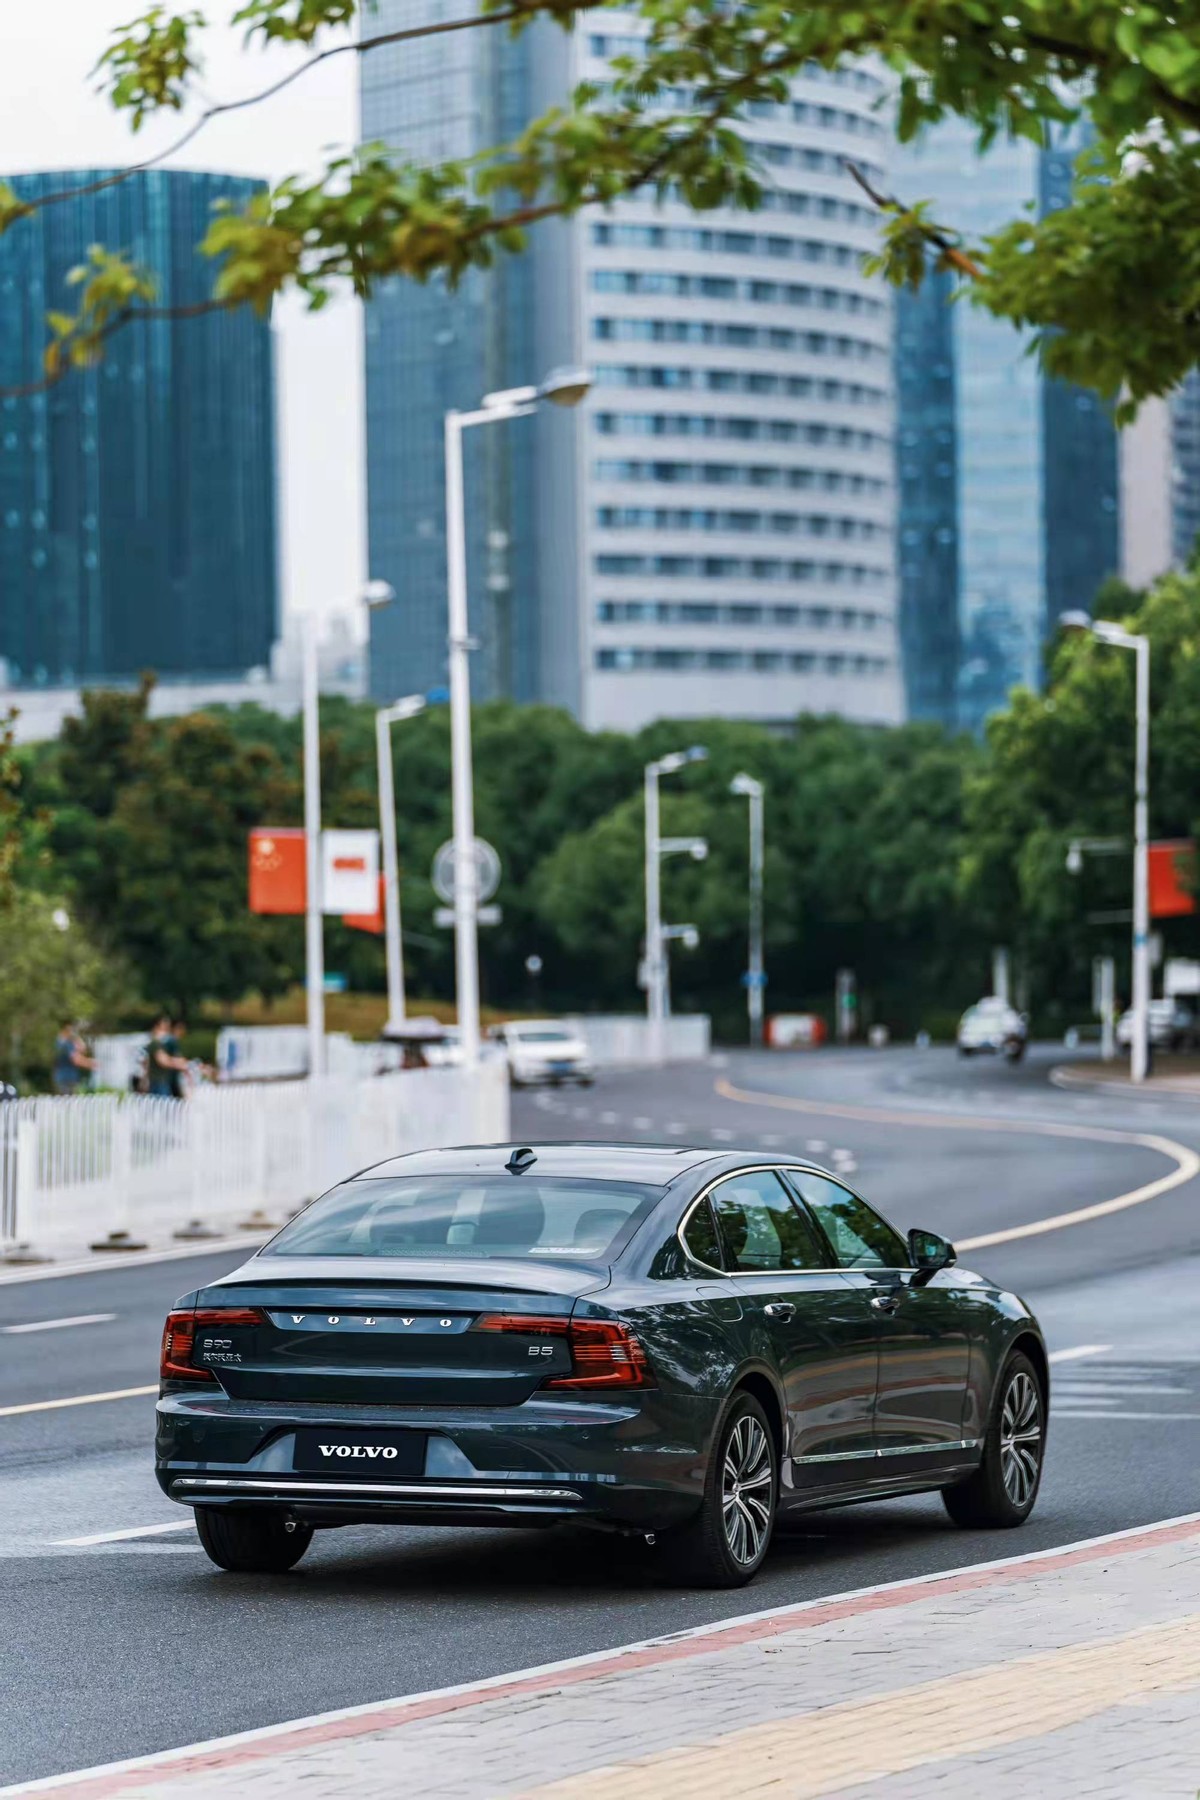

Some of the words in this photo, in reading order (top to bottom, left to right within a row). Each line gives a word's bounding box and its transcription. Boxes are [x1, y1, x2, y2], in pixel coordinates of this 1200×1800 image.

[291, 1315, 452, 1327] VOLVO
[203, 1339, 232, 1349] S90
[528, 1346, 553, 1356] B5
[318, 1445, 398, 1459] VOLVO
